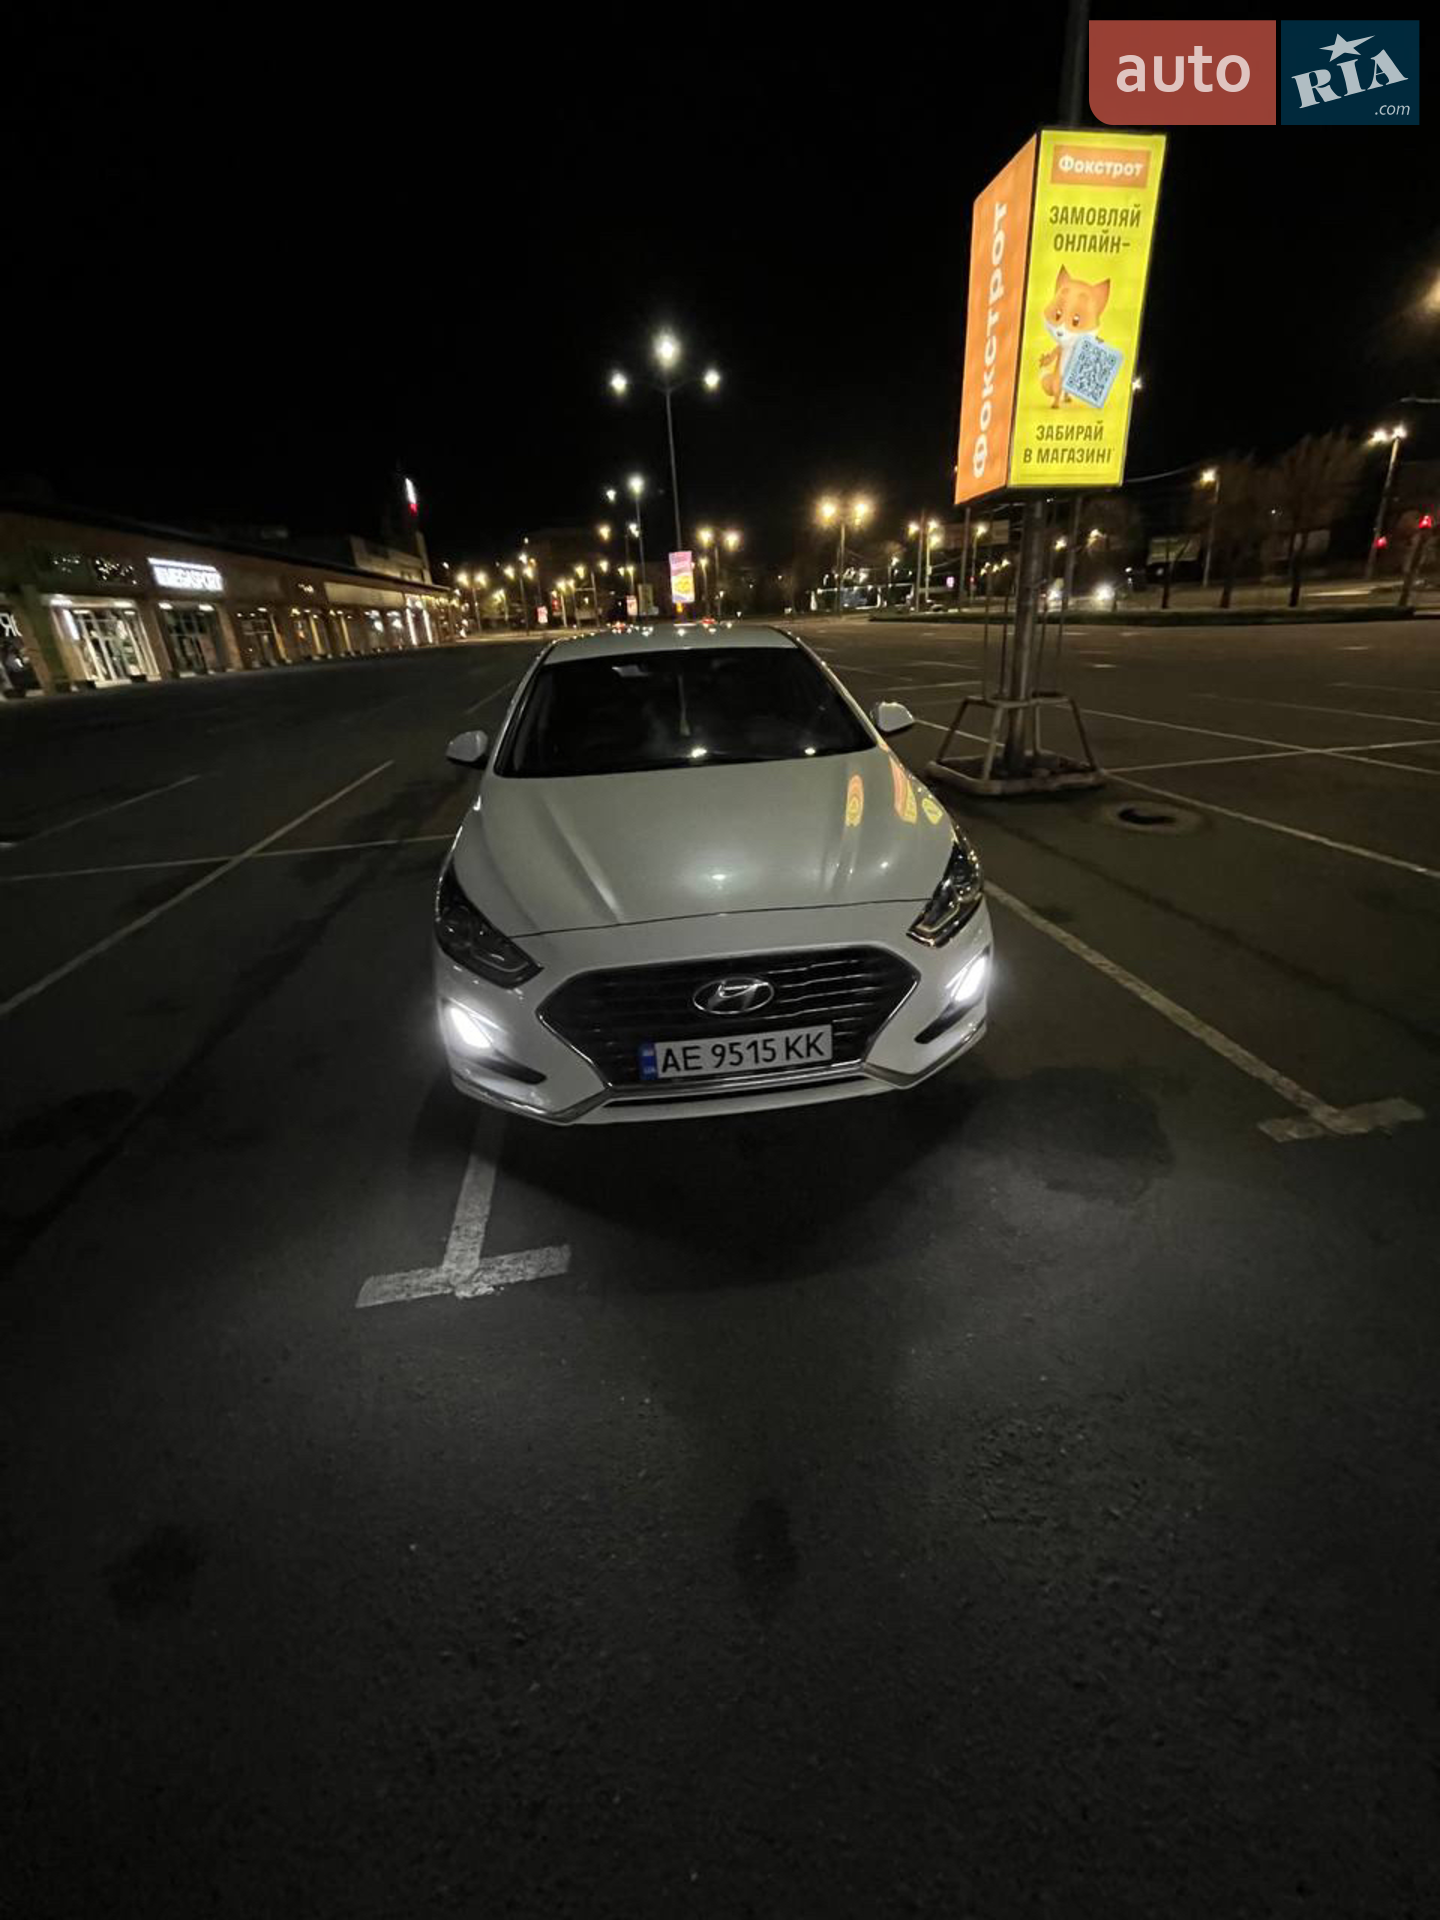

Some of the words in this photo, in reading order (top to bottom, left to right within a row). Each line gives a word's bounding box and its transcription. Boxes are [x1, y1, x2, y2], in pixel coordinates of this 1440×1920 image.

[1058, 154, 1144, 179] Фокстрот
[1049, 203, 1142, 228] ЗАМОВЛЯЙ
[1053, 229, 1131, 254] ОНЛАЙН-
[1035, 420, 1105, 442] ЗАБИРАЙ
[1023, 447, 1033, 464] В
[1036, 447, 1112, 464] МАГАЗИНІ
[661, 1045, 703, 1074] AE
[711, 1037, 777, 1069] 9515
[785, 1031, 825, 1061] KK
